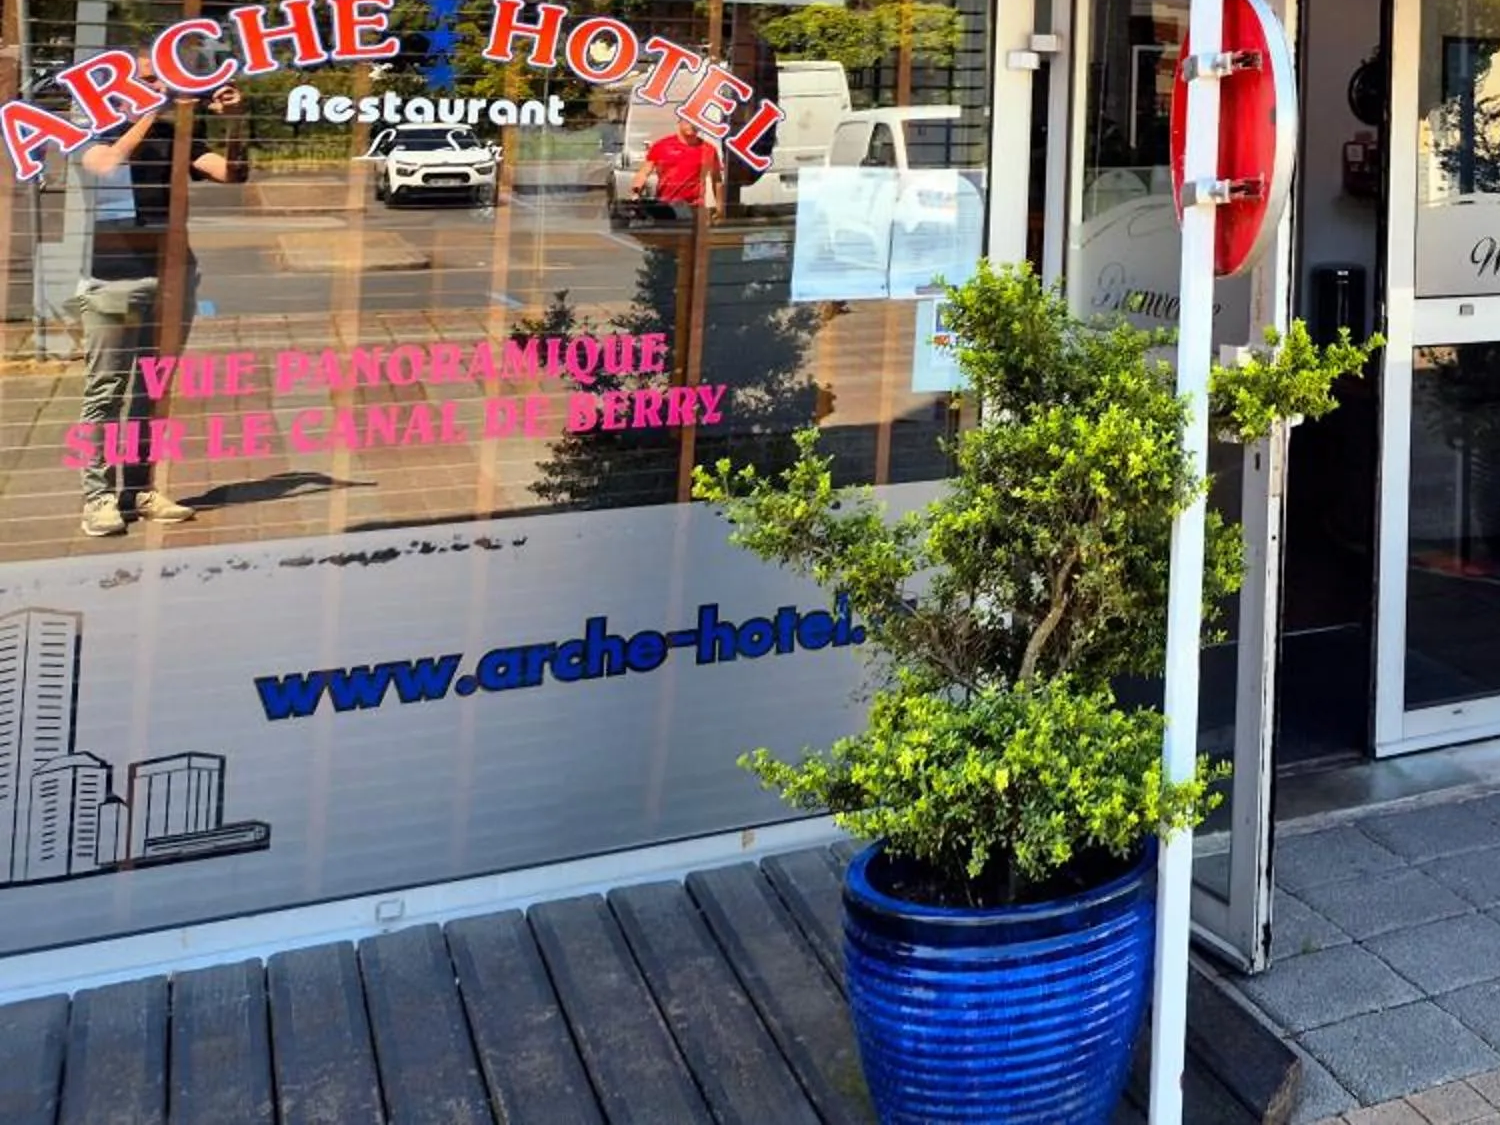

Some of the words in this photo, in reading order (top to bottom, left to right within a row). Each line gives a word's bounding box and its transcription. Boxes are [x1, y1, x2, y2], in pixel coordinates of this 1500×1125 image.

[286, 84, 566, 125] Restaurant
[137, 352, 257, 401] VUE
[275, 332, 668, 395] PANORAMIQUE
[63, 418, 186, 469] SUR
[205, 412, 276, 460] LE
[290, 401, 468, 454] CANAL
[482, 392, 551, 441] DE
[564, 384, 727, 434] BERRY
